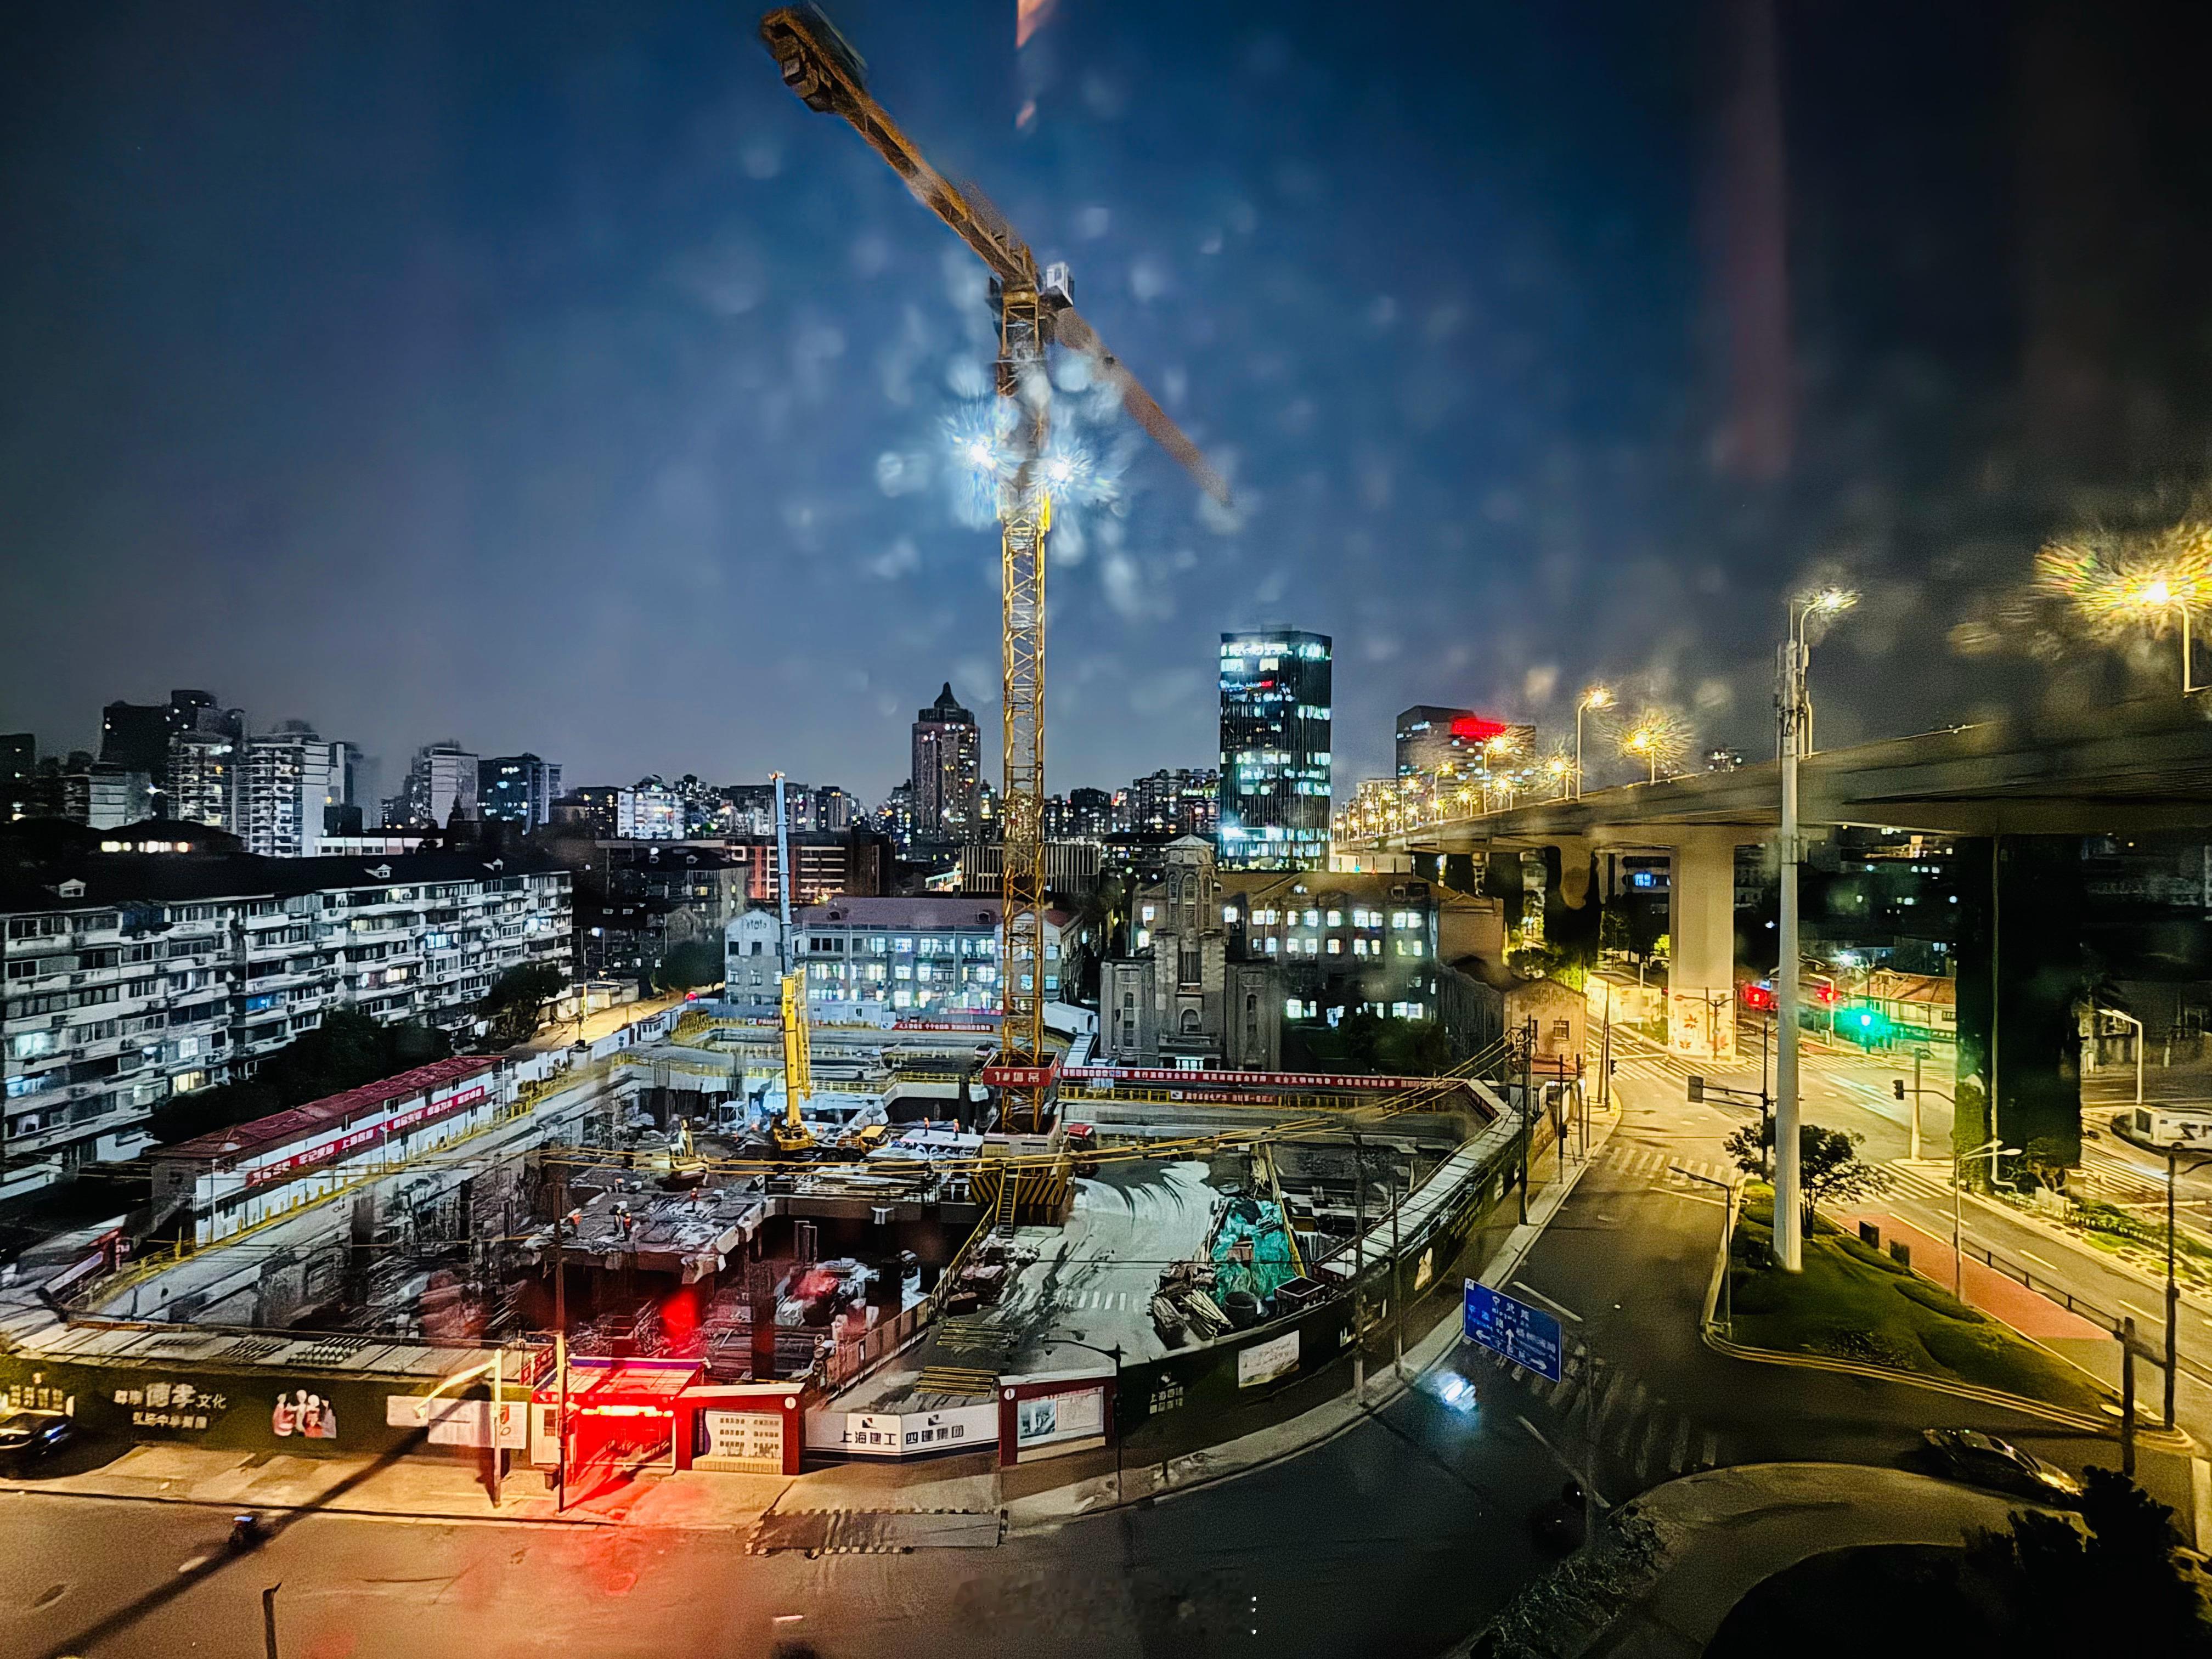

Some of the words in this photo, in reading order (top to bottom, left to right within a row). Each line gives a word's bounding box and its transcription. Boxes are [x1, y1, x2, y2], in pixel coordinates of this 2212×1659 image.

[839, 1430, 896, 1446] 上海建工
[906, 1425, 964, 1444] 四建集团
